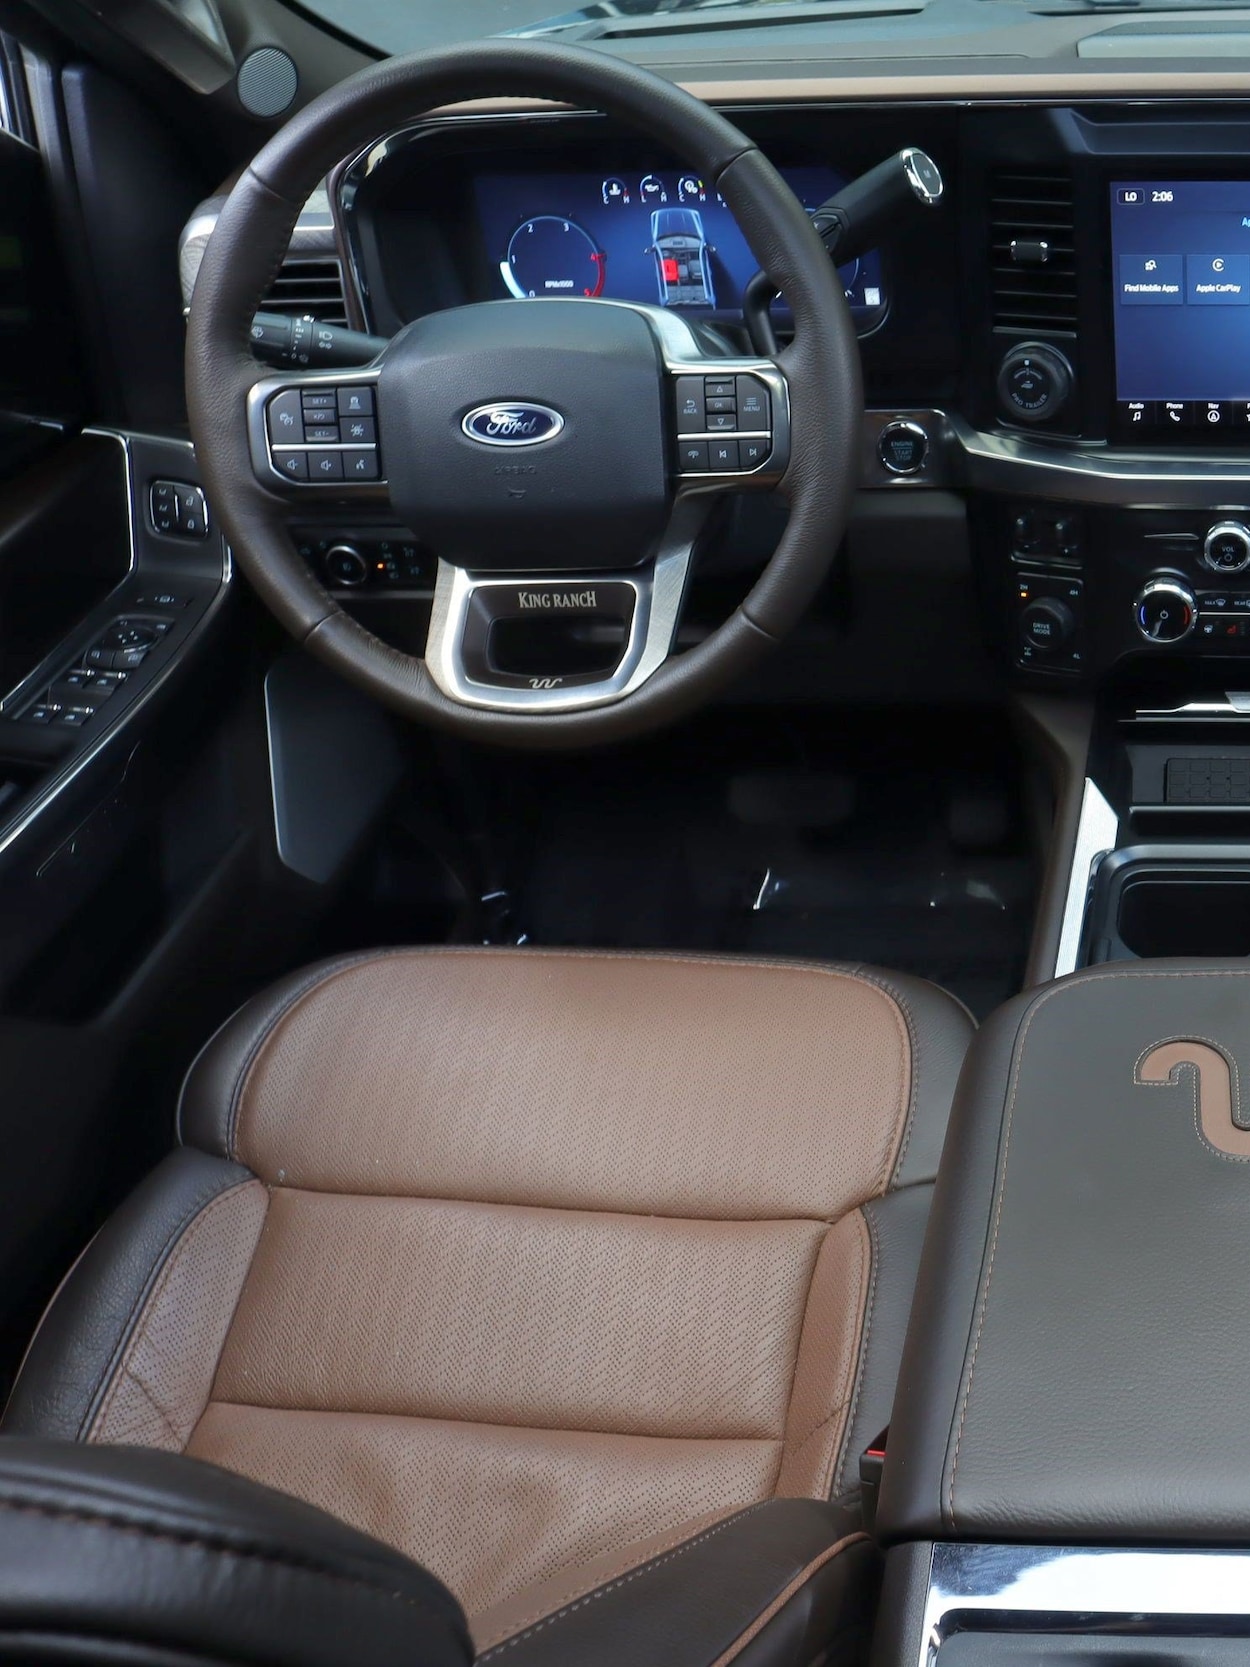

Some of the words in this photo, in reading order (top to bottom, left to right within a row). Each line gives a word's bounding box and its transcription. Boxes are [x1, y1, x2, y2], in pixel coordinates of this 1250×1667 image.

[1124, 192, 1138, 202] LO
[1151, 191, 1174, 202] 2:06
[527, 224, 534, 233] 2
[563, 223, 570, 232] 3
[1124, 284, 1139, 292] Find
[1139, 284, 1161, 292] Mobile
[1161, 284, 1179, 293] Apps
[1195, 284, 1215, 293] Apple
[1215, 284, 1241, 293] CarPlay
[486, 411, 537, 435] Ford
[518, 592, 551, 608] KING
[553, 591, 597, 608] RANCH
